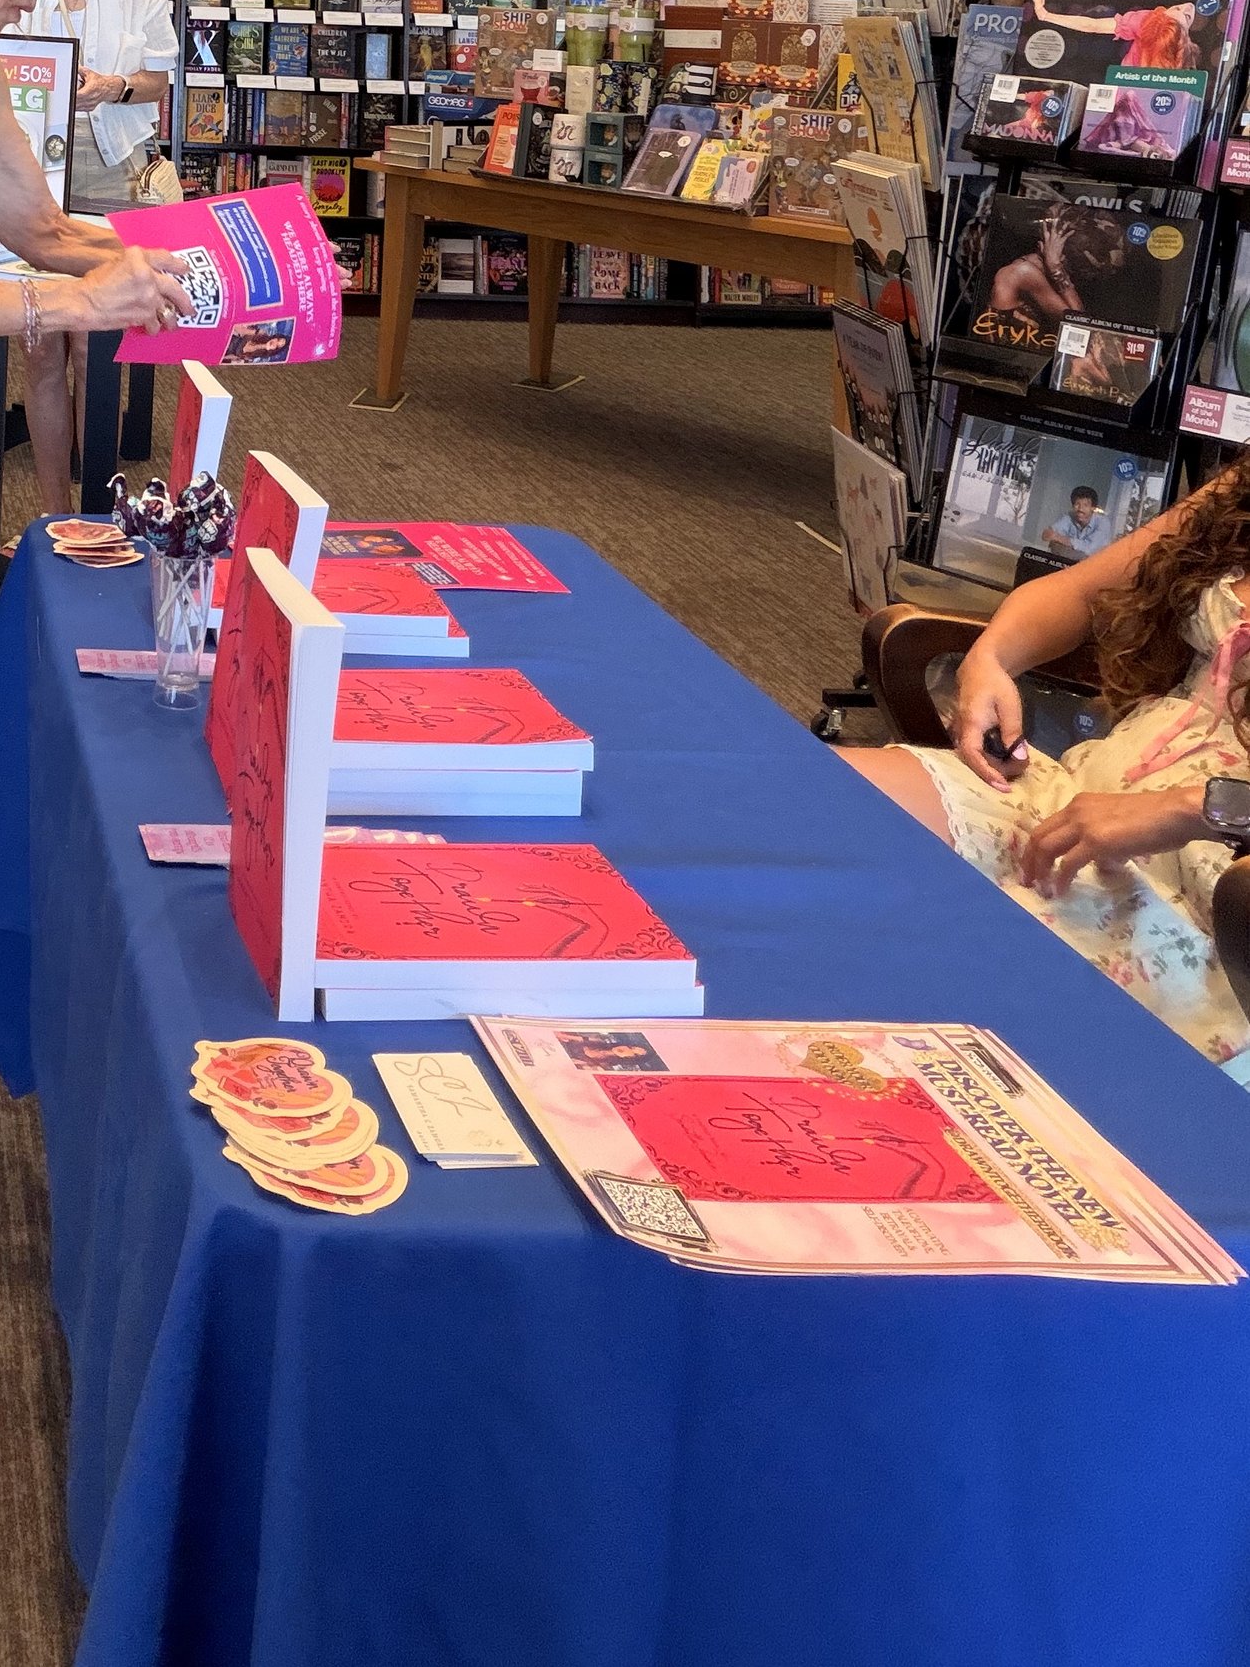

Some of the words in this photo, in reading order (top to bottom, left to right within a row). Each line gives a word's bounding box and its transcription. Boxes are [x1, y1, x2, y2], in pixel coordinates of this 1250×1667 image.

[503, 11, 532, 23] SHIP
[317, 29, 348, 37] CHILDREN
[494, 21, 527, 32] SHOW
[187, 30, 220, 67] X
[19, 65, 52, 83] 50%
[1114, 71, 1140, 81] Artist
[1141, 73, 1151, 82] of
[1151, 73, 1167, 83] the
[1167, 75, 1198, 86] Month
[195, 102, 217, 114] DICE
[800, 113, 835, 128] SHIP
[788, 125, 831, 142] SHOW
[982, 122, 1055, 144] MADONNA
[312, 159, 327, 167] LAST
[309, 220, 324, 242] about
[281, 231, 304, 279] HEADED
[296, 279, 309, 312] HERE
[283, 220, 298, 241] WE
[291, 239, 309, 273] WERE
[302, 273, 316, 323] ALWAYS
[328, 280, 338, 297] and
[330, 310, 338, 336] choice
[1065, 314, 1089, 325] CLASSIC
[1090, 318, 1113, 329] ALBUM
[1113, 322, 1123, 330] OF
[1123, 324, 1135, 332] THE
[1189, 397, 1221, 412] Album
[1200, 409, 1213, 417] the
[1019, 414, 1044, 426] CLASSIC
[1044, 420, 1064, 430] ALBUM
[1073, 425, 1085, 435] THE
[1185, 413, 1218, 428] Month
[1023, 551, 1048, 566] CLASSIC
[817, 1041, 856, 1067] ORDER
[843, 1067, 880, 1090] YOUR
[913, 1062, 1023, 1161] MUST-READ
[1010, 1160, 1085, 1227] NOVEL
[937, 1060, 1034, 1145] DISCOVER
[1024, 1145, 1079, 1187] THE
[1070, 1186, 1128, 1232] NEW
